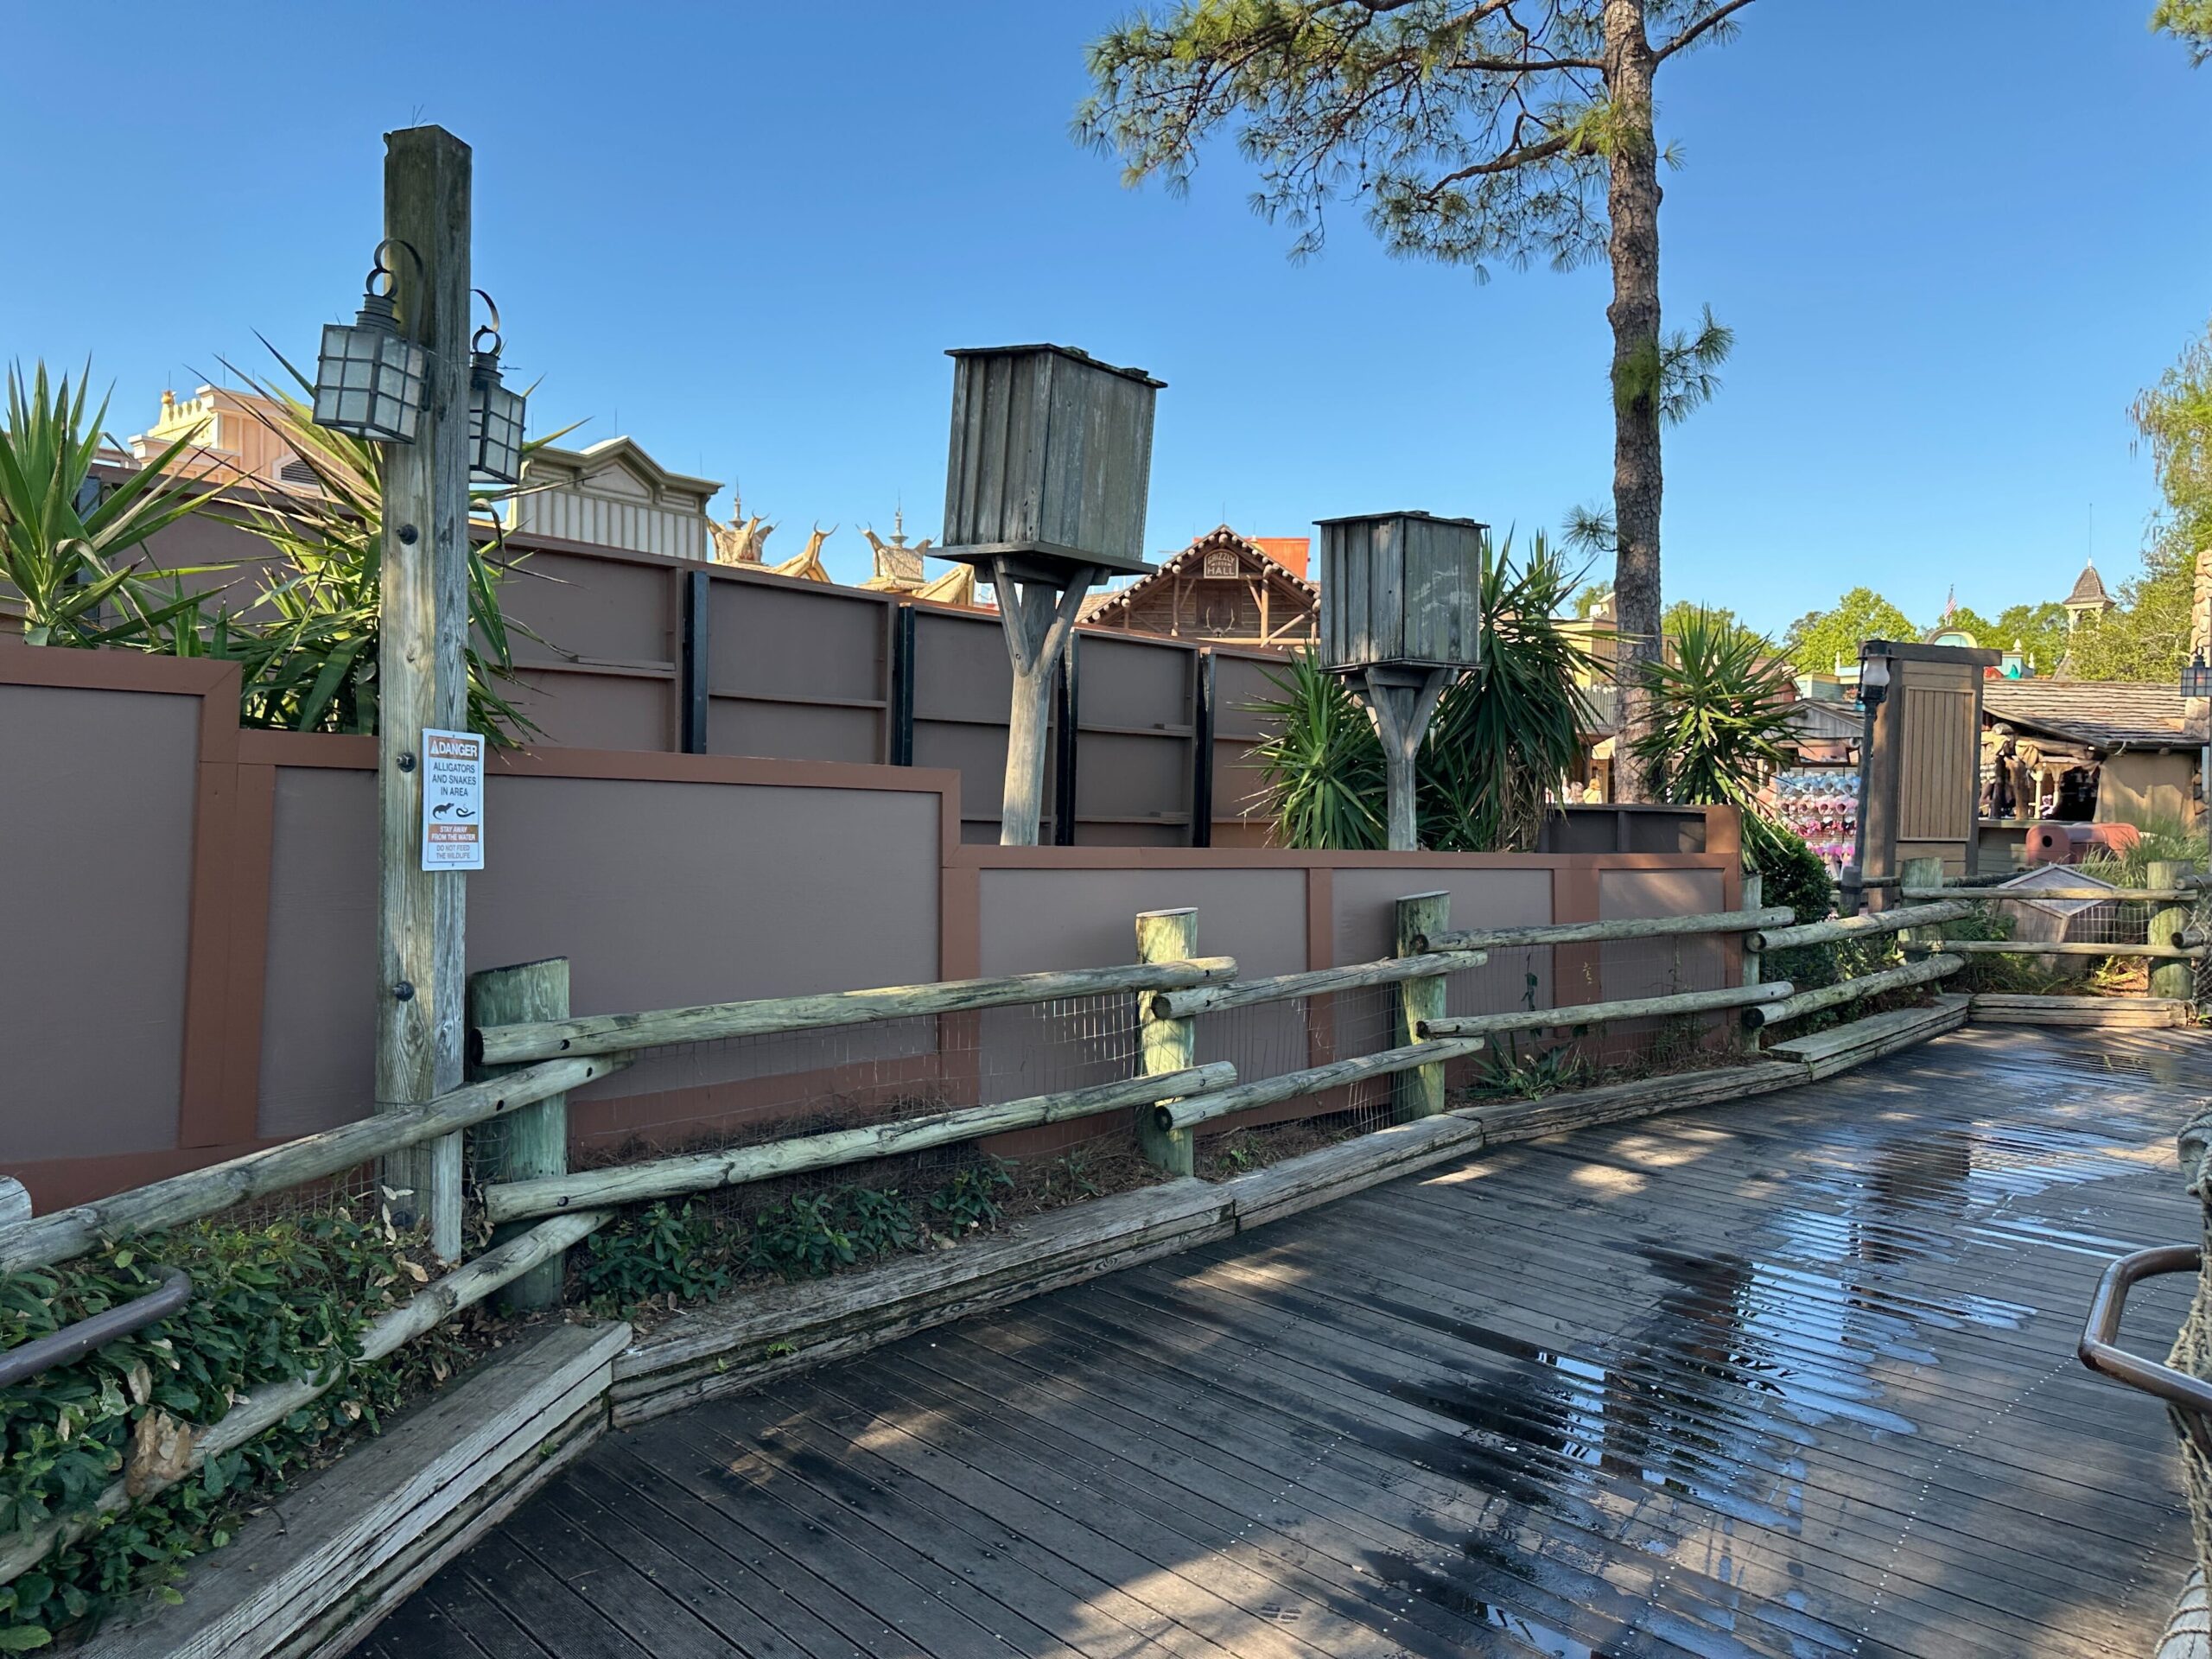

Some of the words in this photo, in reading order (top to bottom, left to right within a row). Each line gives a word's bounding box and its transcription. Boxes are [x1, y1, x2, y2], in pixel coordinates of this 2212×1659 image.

[1208, 553, 1235, 564] GRIZZLY
[439, 741, 477, 757] DANGER
[433, 762, 475, 773] ALLIGATORS
[432, 774, 447, 784] AND
[449, 775, 476, 785] SNAKES
[441, 786, 448, 795] IN
[450, 787, 468, 796] AREA
